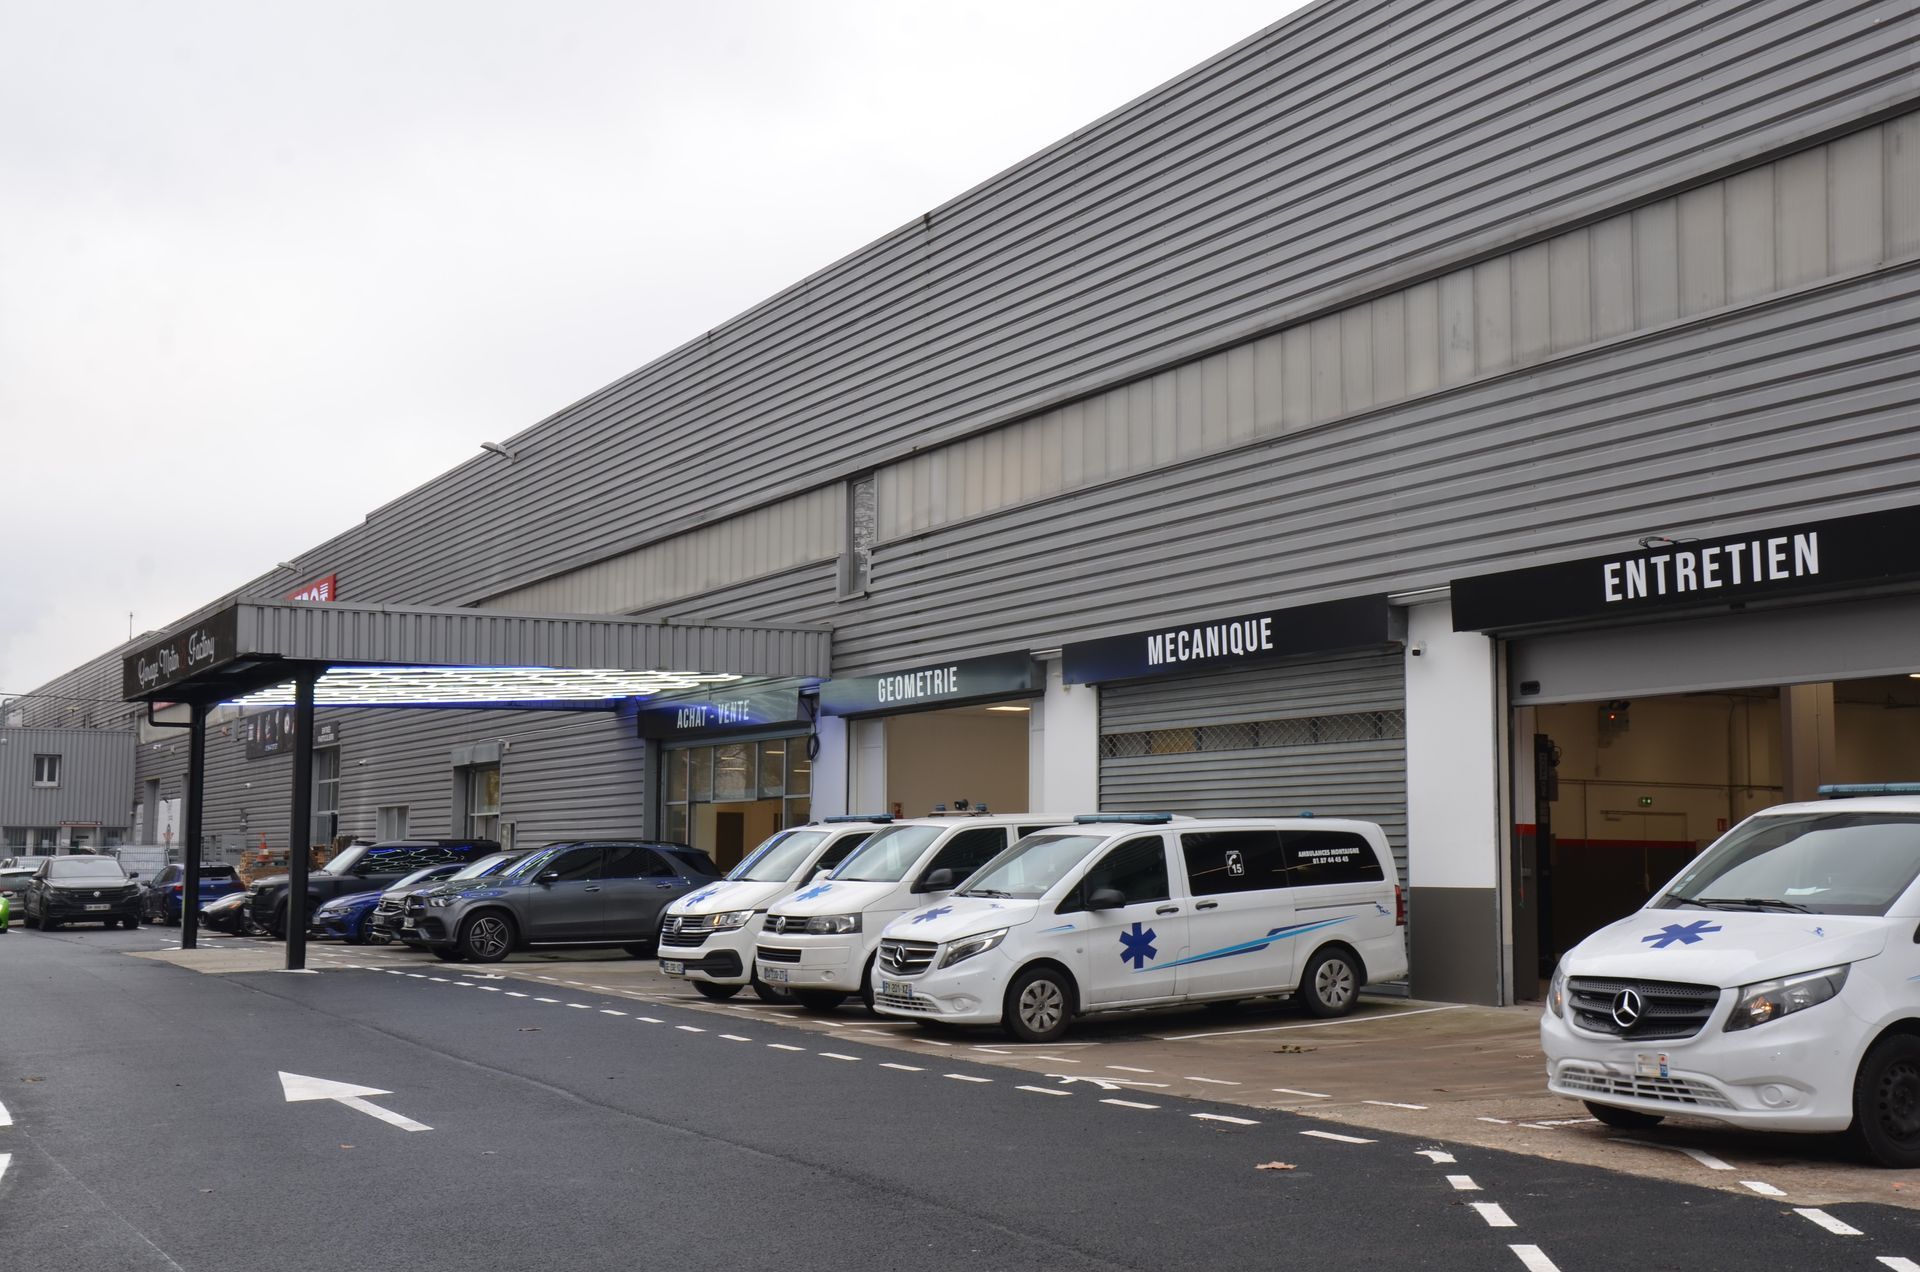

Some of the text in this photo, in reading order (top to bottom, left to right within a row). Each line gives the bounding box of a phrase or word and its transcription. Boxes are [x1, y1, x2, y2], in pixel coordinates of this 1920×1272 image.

[1603, 531, 1820, 603] ENTRETIEN
[1146, 617, 1274, 667] MECANIQUE
[877, 666, 959, 704] GEOMETRIE
[676, 705, 708, 730] ACHAT
[717, 699, 750, 724] VENTE
[1231, 863, 1242, 874] 15
[1298, 849, 1331, 858] AMBULANCES
